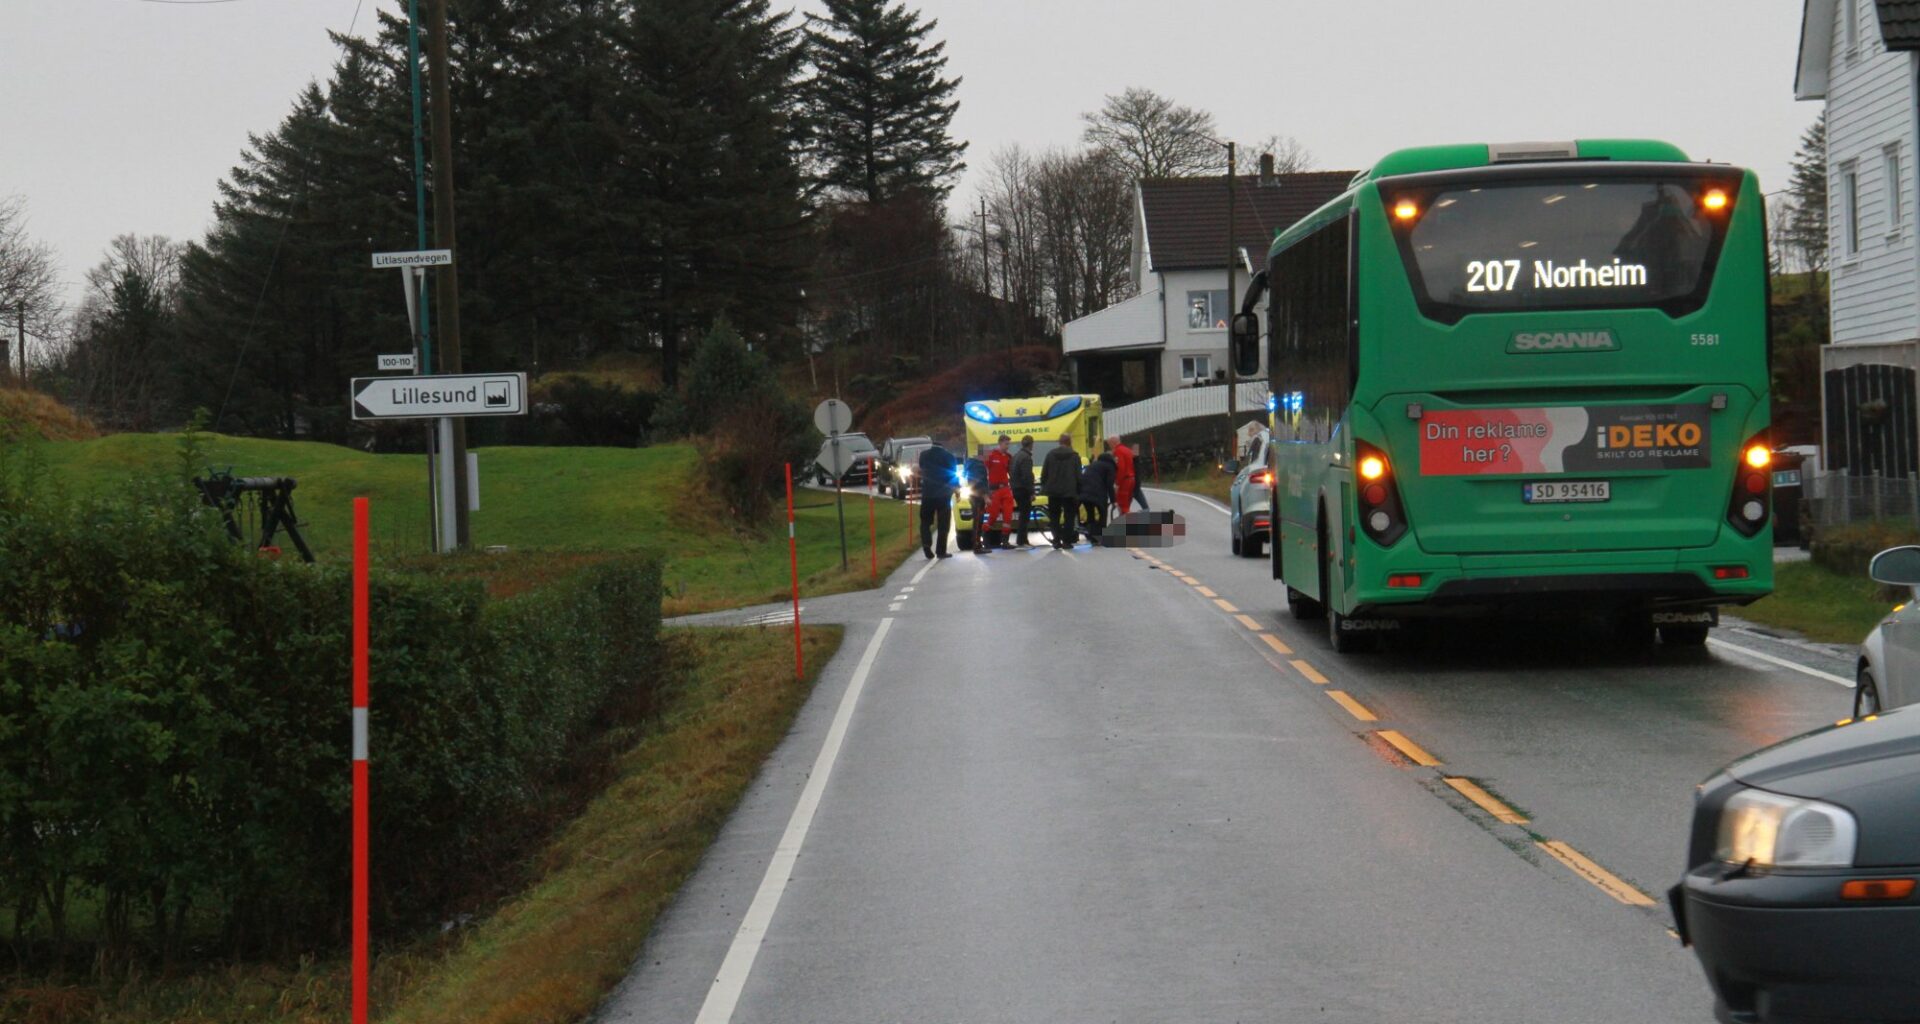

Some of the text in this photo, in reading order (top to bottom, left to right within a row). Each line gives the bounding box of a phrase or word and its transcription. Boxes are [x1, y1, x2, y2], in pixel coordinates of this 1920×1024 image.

[376, 253, 448, 265] Litlasundvegen
[1466, 258, 1647, 292] 207 Norheim
[1514, 331, 1614, 350] SCANIA
[1690, 333, 1720, 346] 5581
[382, 357, 411, 367] 100-110
[391, 386, 477, 405] Lillesund
[992, 427, 1050, 436] AMBULANSE
[1426, 422, 1547, 440] Din reklame
[1597, 422, 1702, 448] iDEKO
[1462, 444, 1511, 462] her ?
[1597, 448, 1700, 459] SKILT OG REKLAME
[1536, 483, 1605, 498] SD 95416
[1652, 612, 1712, 623] SCANIA
